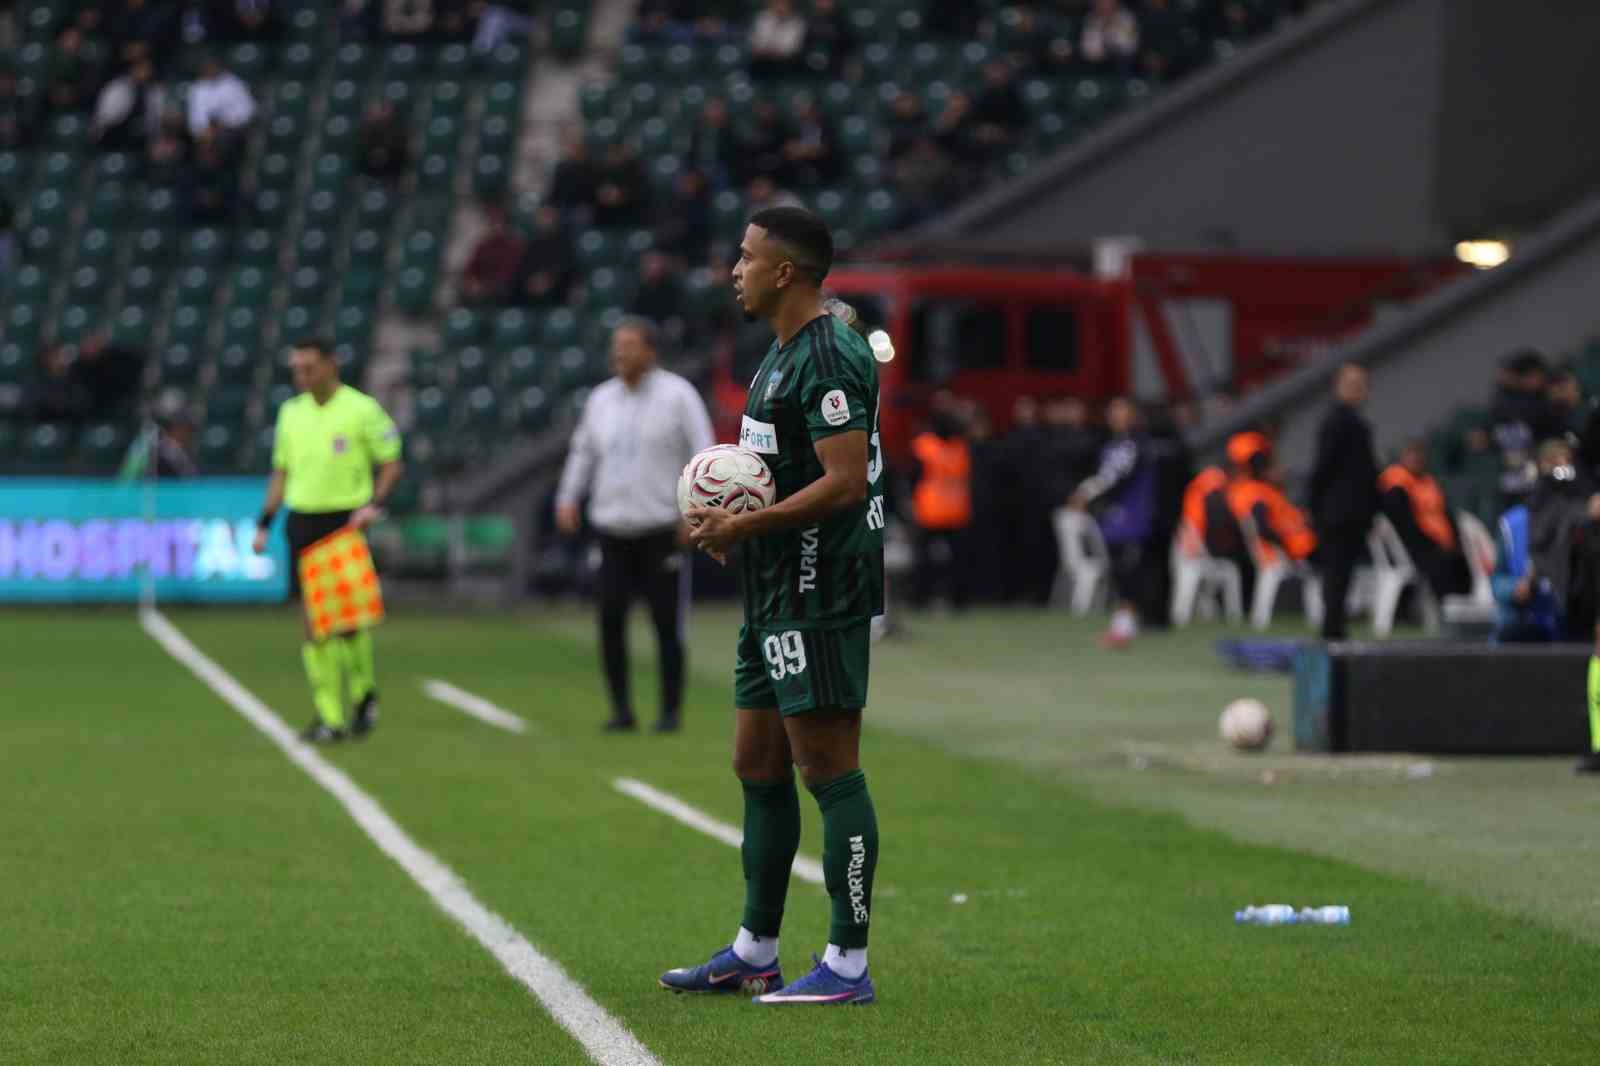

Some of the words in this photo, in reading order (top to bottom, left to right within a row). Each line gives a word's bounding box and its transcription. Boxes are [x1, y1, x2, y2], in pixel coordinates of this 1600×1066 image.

[0, 517, 276, 581] HOSPITAL
[763, 630, 807, 681] 99
[848, 835, 869, 924] SPORTRUN
